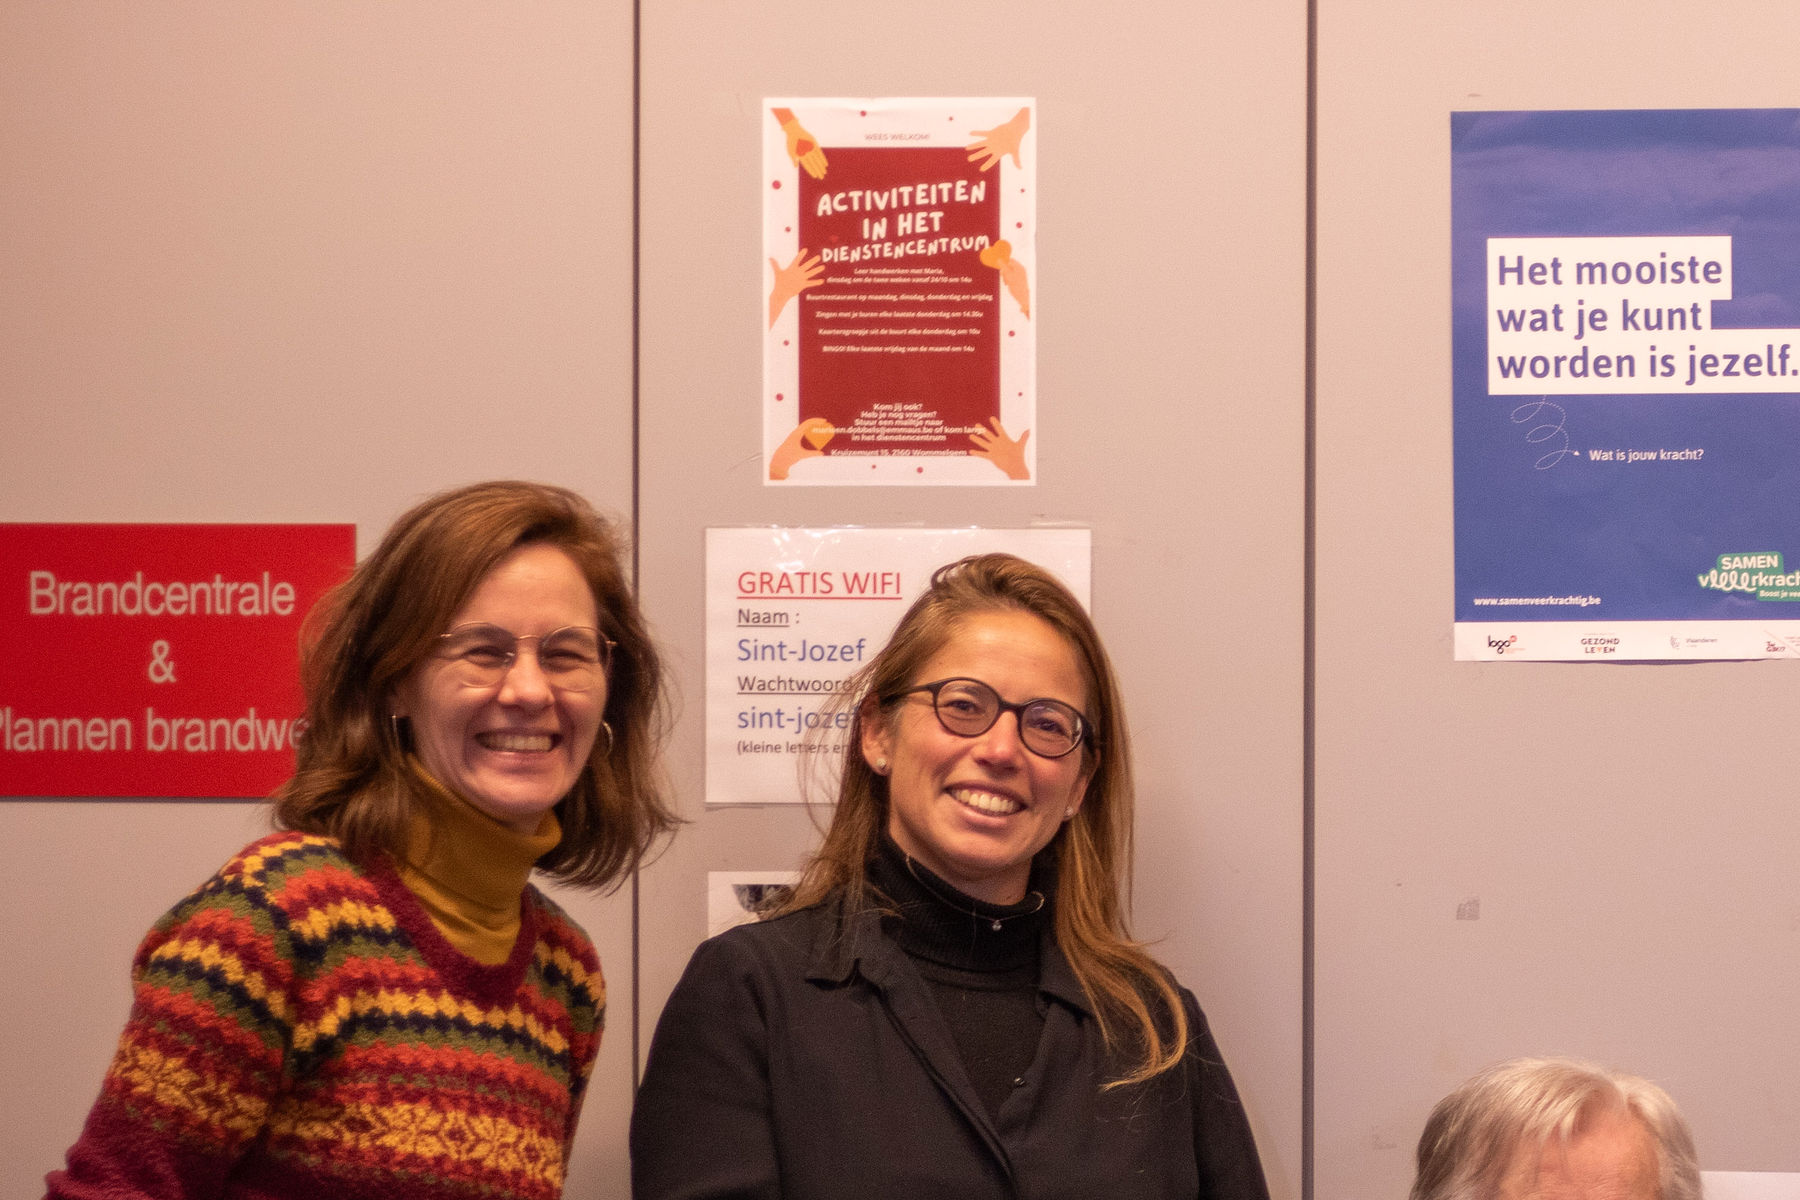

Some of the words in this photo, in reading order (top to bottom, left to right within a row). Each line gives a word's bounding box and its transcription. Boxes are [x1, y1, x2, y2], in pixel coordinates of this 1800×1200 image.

[816, 180, 987, 217] ACTIVITEITEN
[862, 217, 887, 241] IN
[897, 211, 944, 237] HET
[822, 235, 990, 263] DIENSTENCENTRUM
[1499, 255, 1563, 285] Het
[1576, 252, 1722, 284] mooiste
[1496, 303, 1564, 332] wat
[1574, 299, 1608, 340] je
[1622, 299, 1702, 330] kunt
[1496, 346, 1635, 378] worden
[1650, 345, 1675, 377] is
[1685, 344, 1799, 386] jezelf.
[1589, 449, 1613, 461] Wat
[1616, 449, 1626, 460] is
[1627, 449, 1657, 463] jouw
[1660, 448, 1704, 460] kracht?
[1721, 555, 1778, 570] SAMEN
[29, 571, 296, 617] Brandcentrale
[737, 571, 833, 595] GRATIS
[842, 572, 901, 595] WIFI
[1474, 595, 1601, 607] www.samenveerkrachtig.be
[738, 608, 789, 624] Naam
[147, 639, 176, 684] &
[737, 638, 866, 662] Sint-Jozef
[737, 741, 782, 755] (kleine
[786, 741, 829, 753] letters
